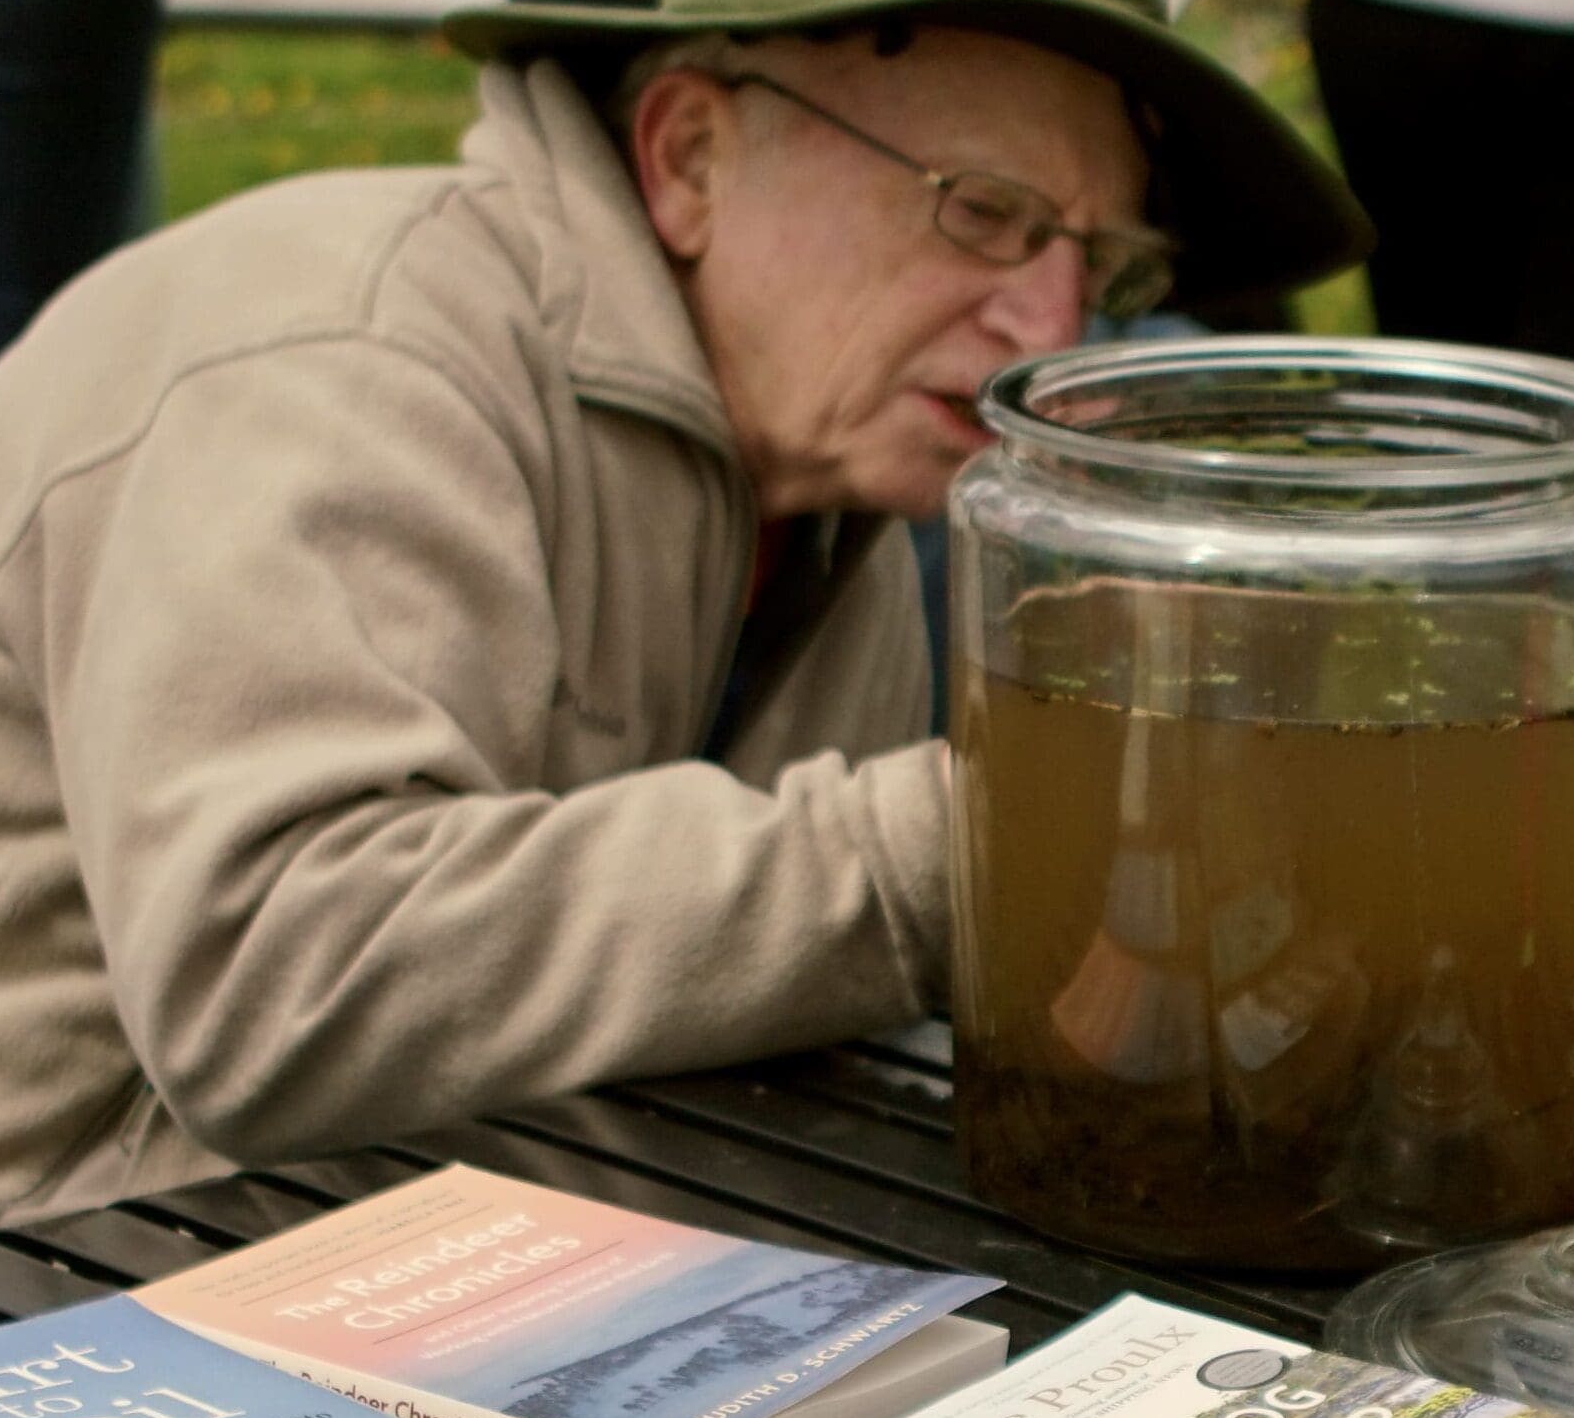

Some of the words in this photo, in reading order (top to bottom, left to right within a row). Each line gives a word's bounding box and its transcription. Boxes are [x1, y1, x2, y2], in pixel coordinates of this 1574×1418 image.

[273, 1292, 350, 1322] The
[333, 1211, 540, 1299] Reindeer
[342, 1235, 582, 1330] Chronicles
[776, 1370, 809, 1385] D.
[804, 1301, 924, 1369] SCHWARTZ
[1026, 1322, 1199, 1414] Proulx
